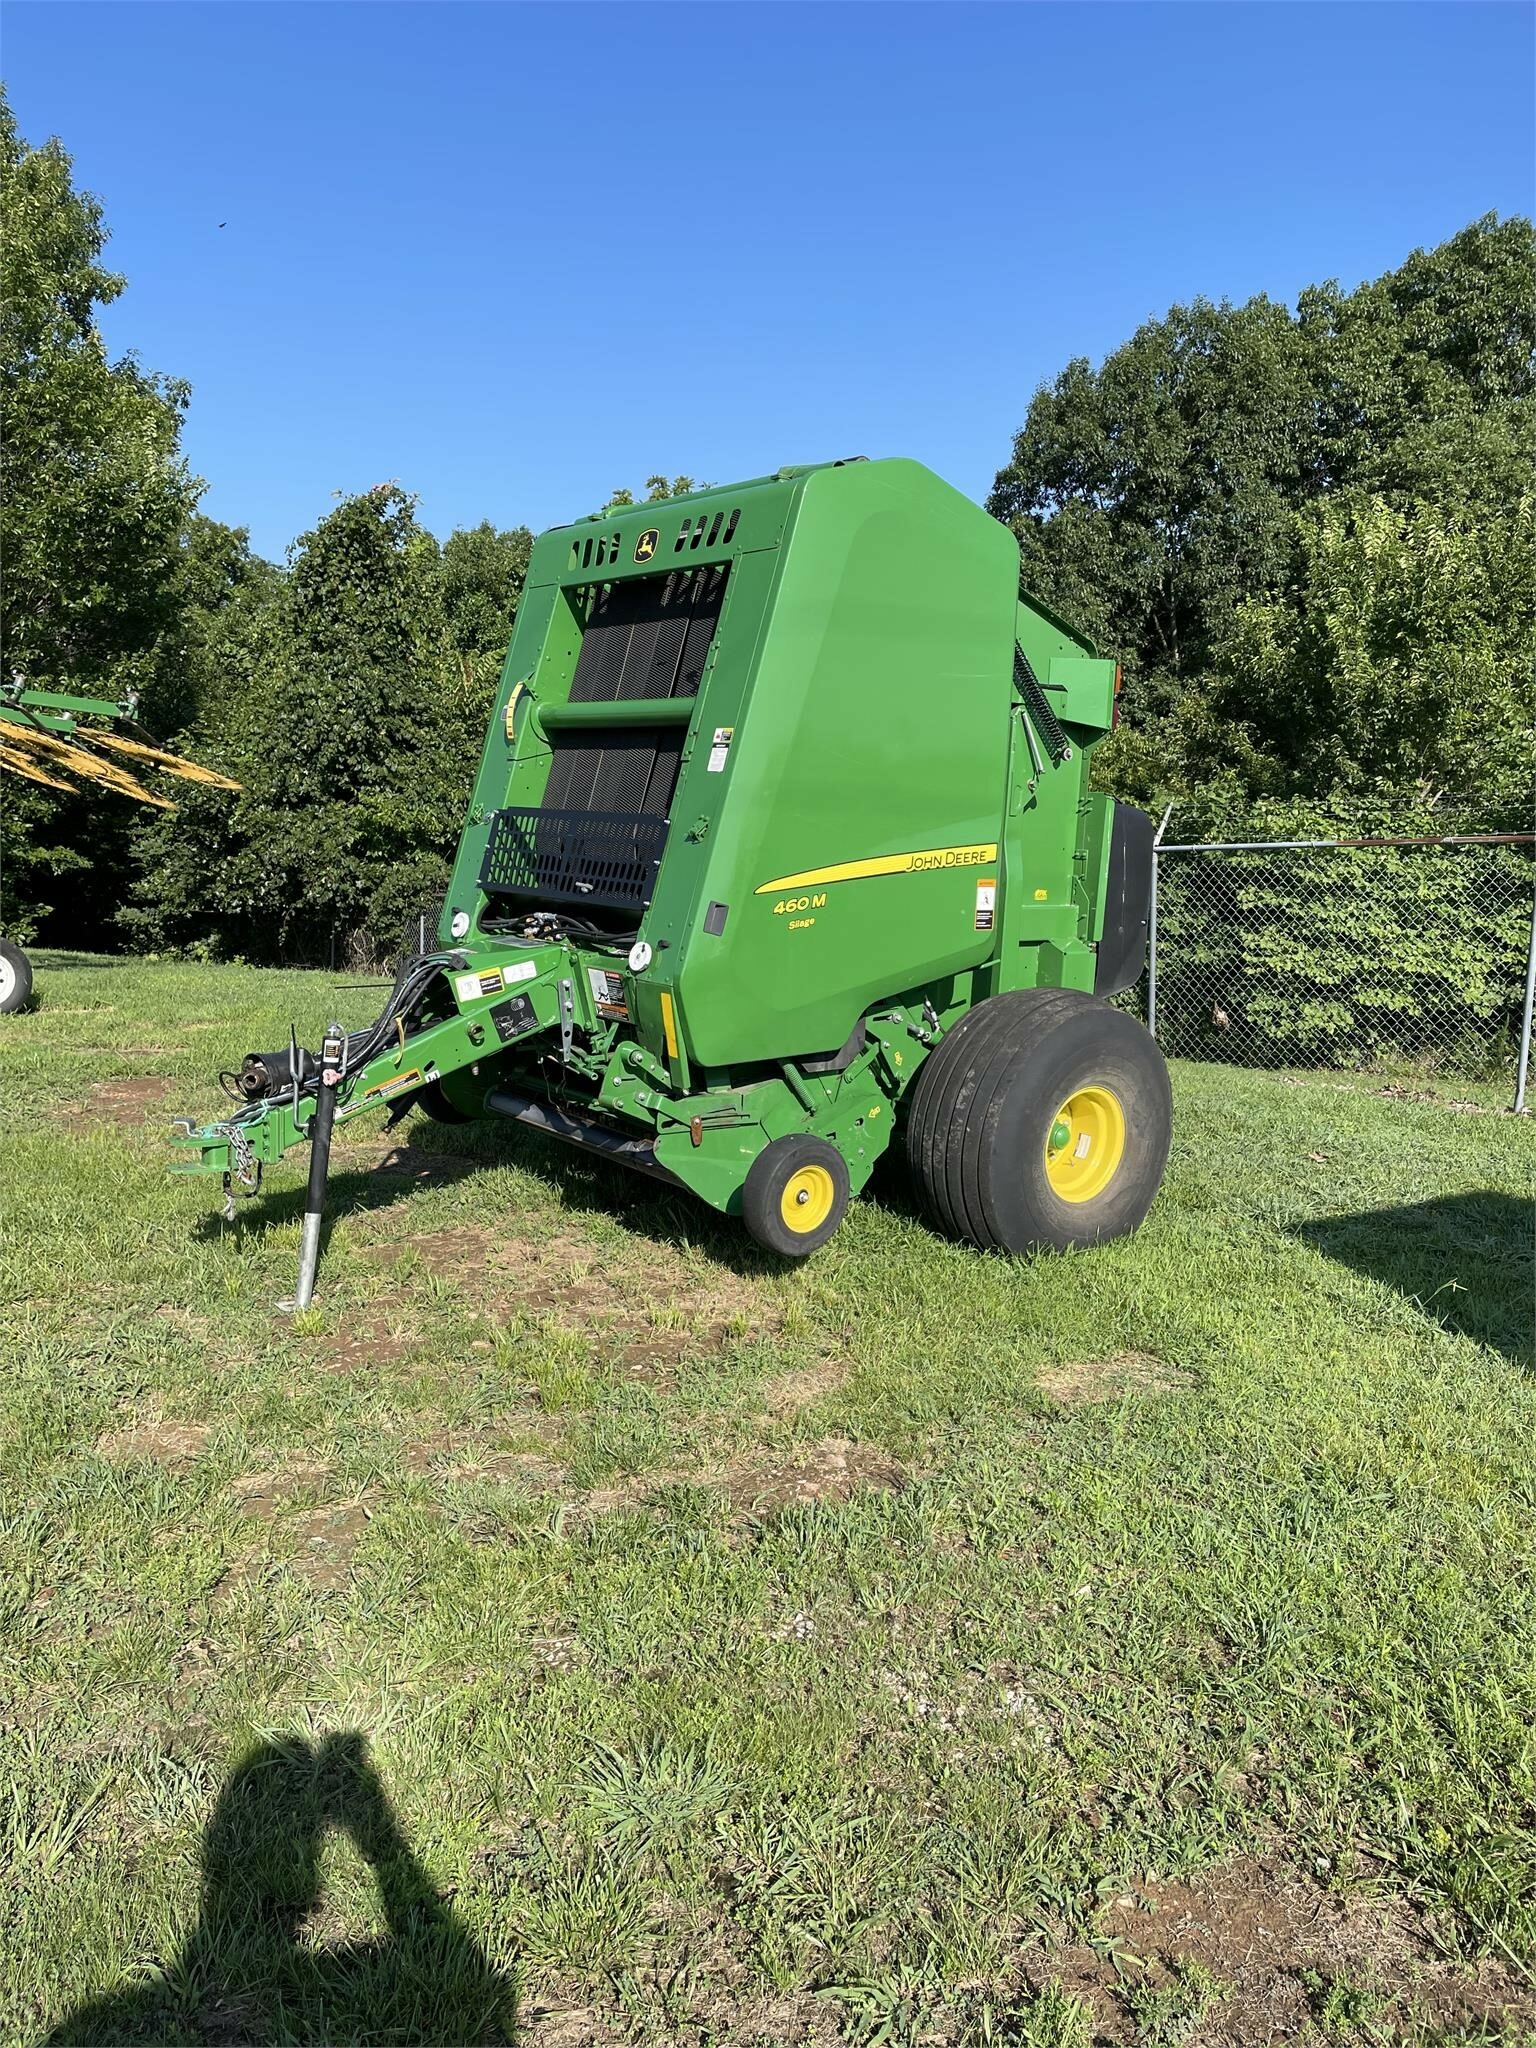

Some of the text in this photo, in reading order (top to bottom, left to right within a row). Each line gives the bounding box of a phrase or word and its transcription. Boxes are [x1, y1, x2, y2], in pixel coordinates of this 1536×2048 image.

[906, 851, 987, 870] JOHN DEERE
[773, 892, 827, 915] 460 M
[788, 917, 815, 930] Silage
